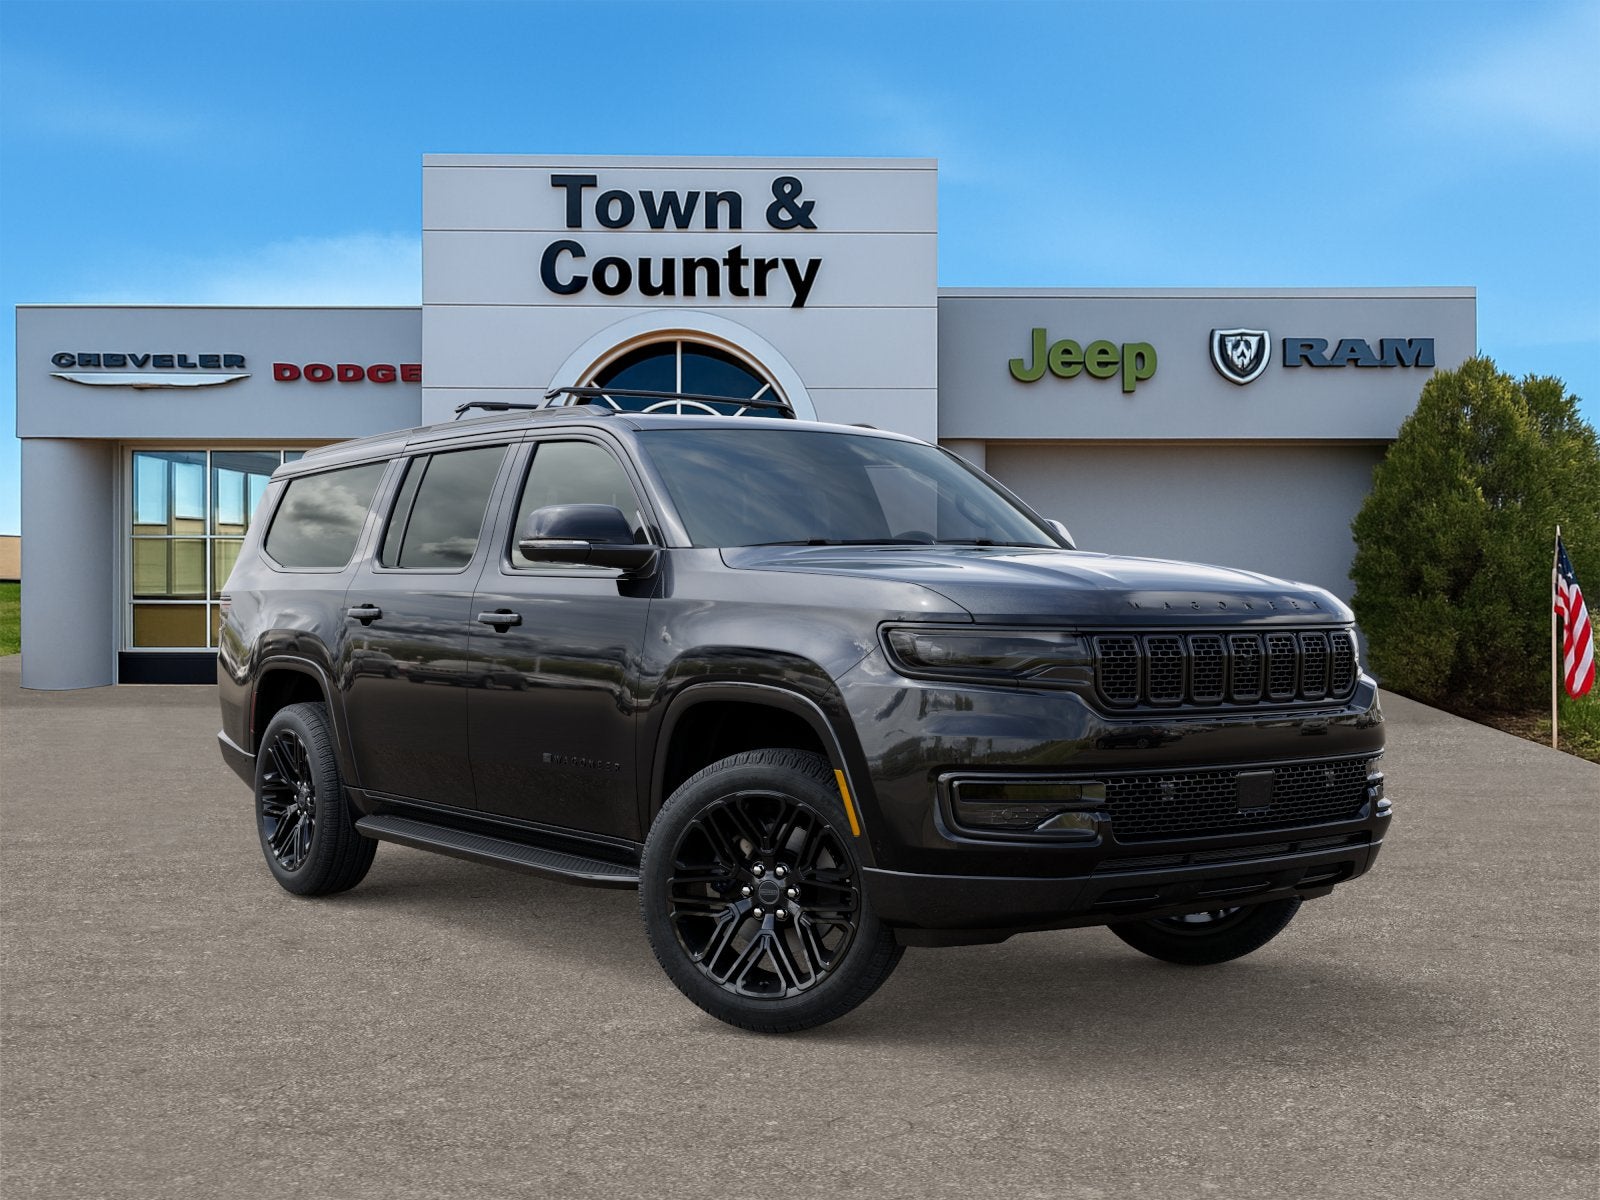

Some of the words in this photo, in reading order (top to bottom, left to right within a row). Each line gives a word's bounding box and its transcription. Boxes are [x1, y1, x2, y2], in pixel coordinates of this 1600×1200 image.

[550, 174, 743, 230] Town
[765, 175, 818, 231] &
[539, 239, 823, 309] Country
[272, 362, 421, 384] DODGE
[1008, 327, 1158, 393] Jeep
[1282, 337, 1436, 368] RAM
